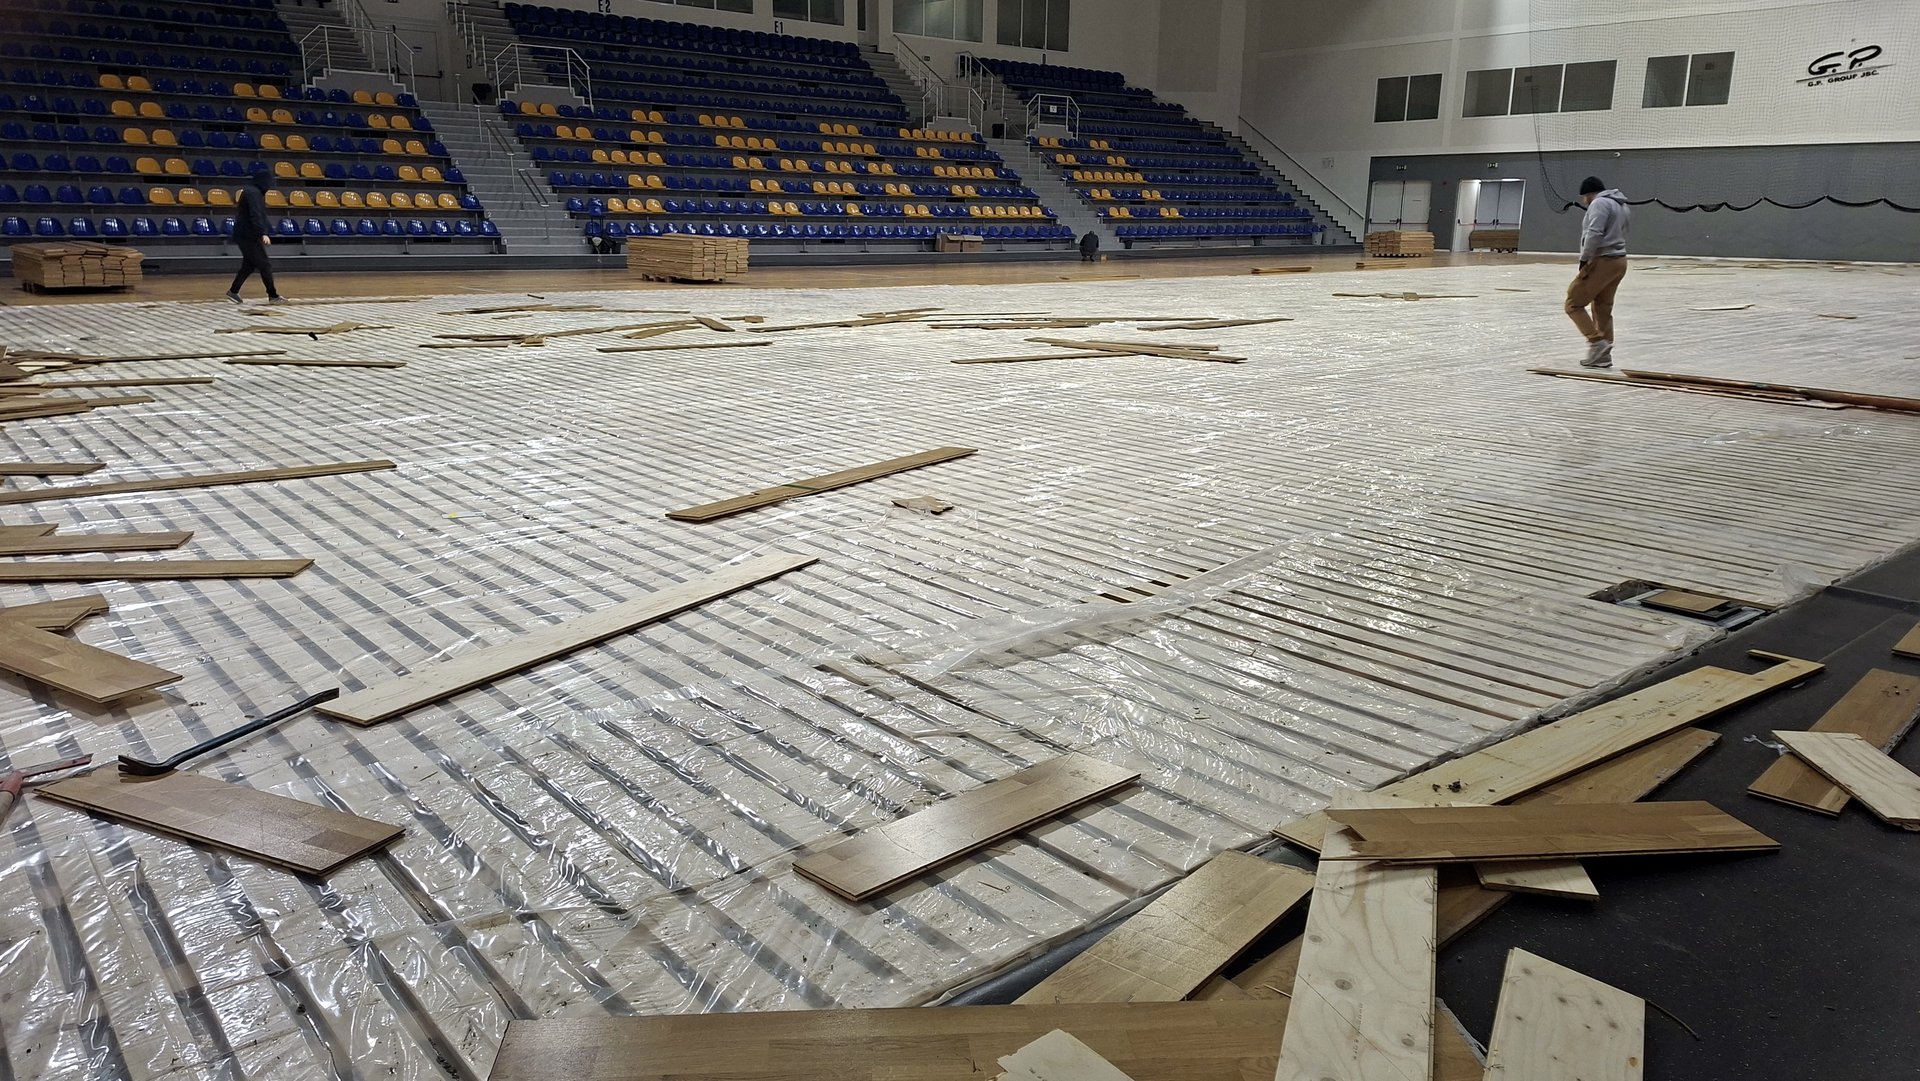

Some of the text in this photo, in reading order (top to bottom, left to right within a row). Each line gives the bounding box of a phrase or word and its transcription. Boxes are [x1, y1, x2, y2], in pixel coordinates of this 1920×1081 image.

[598, 0, 611, 13] E2
[774, 20, 783, 34] E1
[1828, 74, 1857, 83] GROUP
